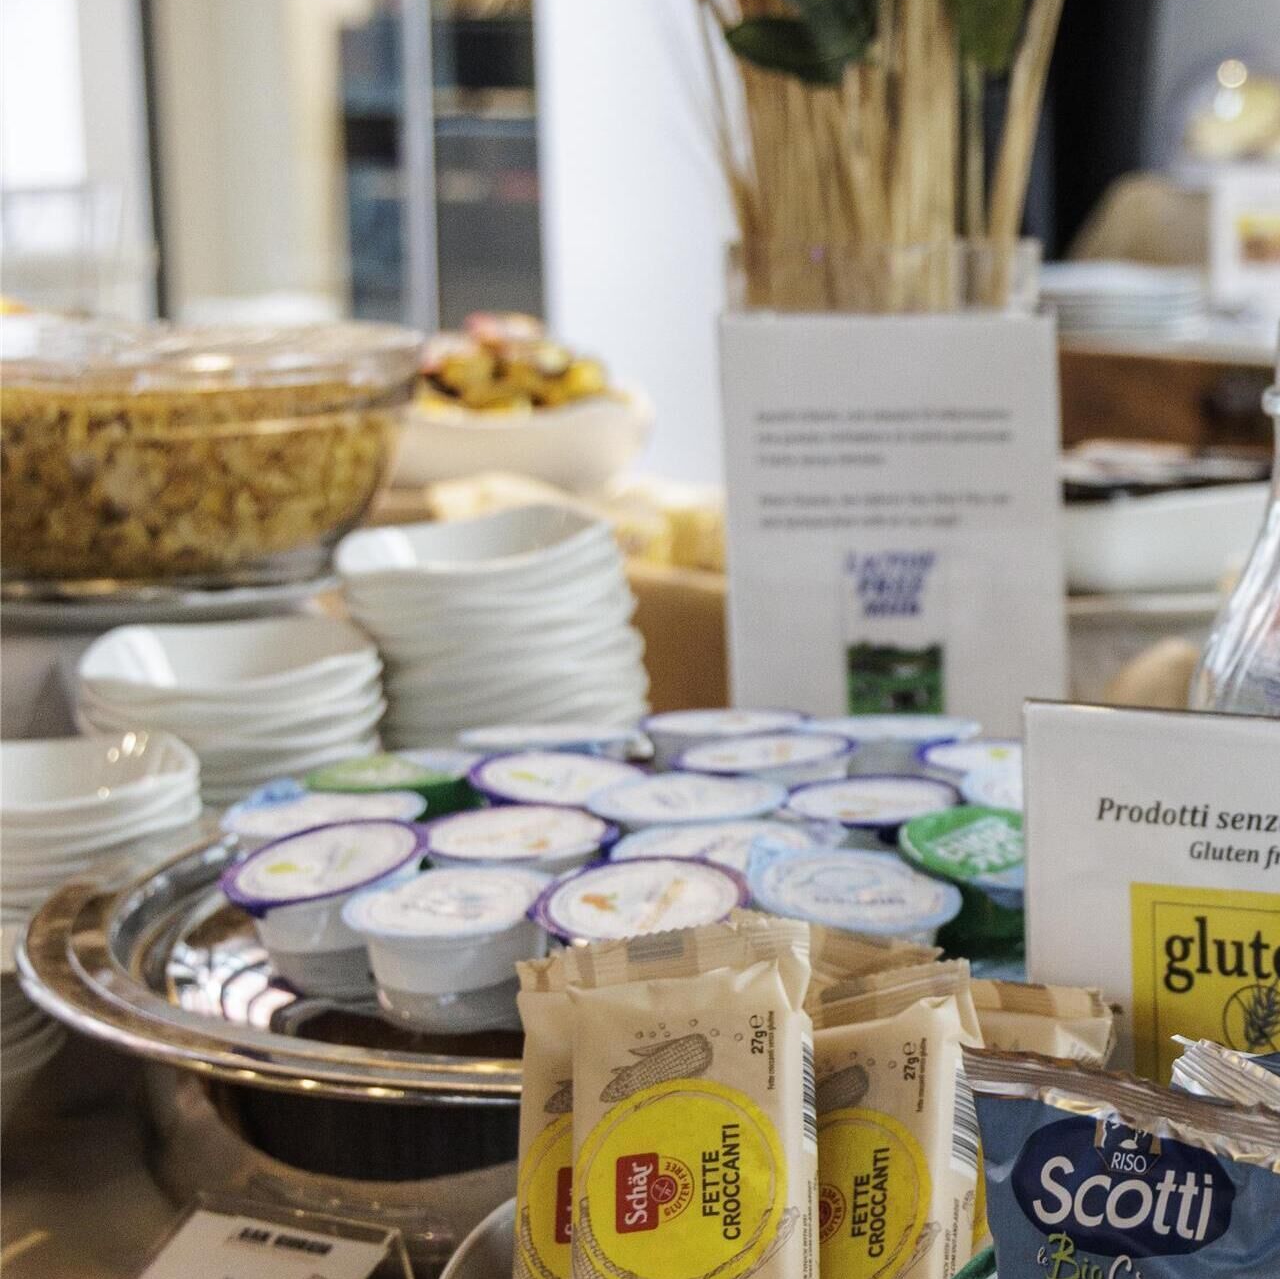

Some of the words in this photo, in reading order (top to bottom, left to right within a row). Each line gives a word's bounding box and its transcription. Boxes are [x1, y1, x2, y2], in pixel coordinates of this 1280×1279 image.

[1097, 797, 1210, 828] Prodotti
[1189, 841, 1260, 864] Gluten
[624, 1162, 653, 1226] Schär
[702, 1149, 721, 1218] FETTE
[722, 1122, 742, 1241] CROCCANTI
[1110, 1152, 1147, 1173] RISO
[851, 1173, 871, 1239] FETTE
[868, 1146, 891, 1259] CROCCANTI
[1033, 1156, 1214, 1241] Scotti
